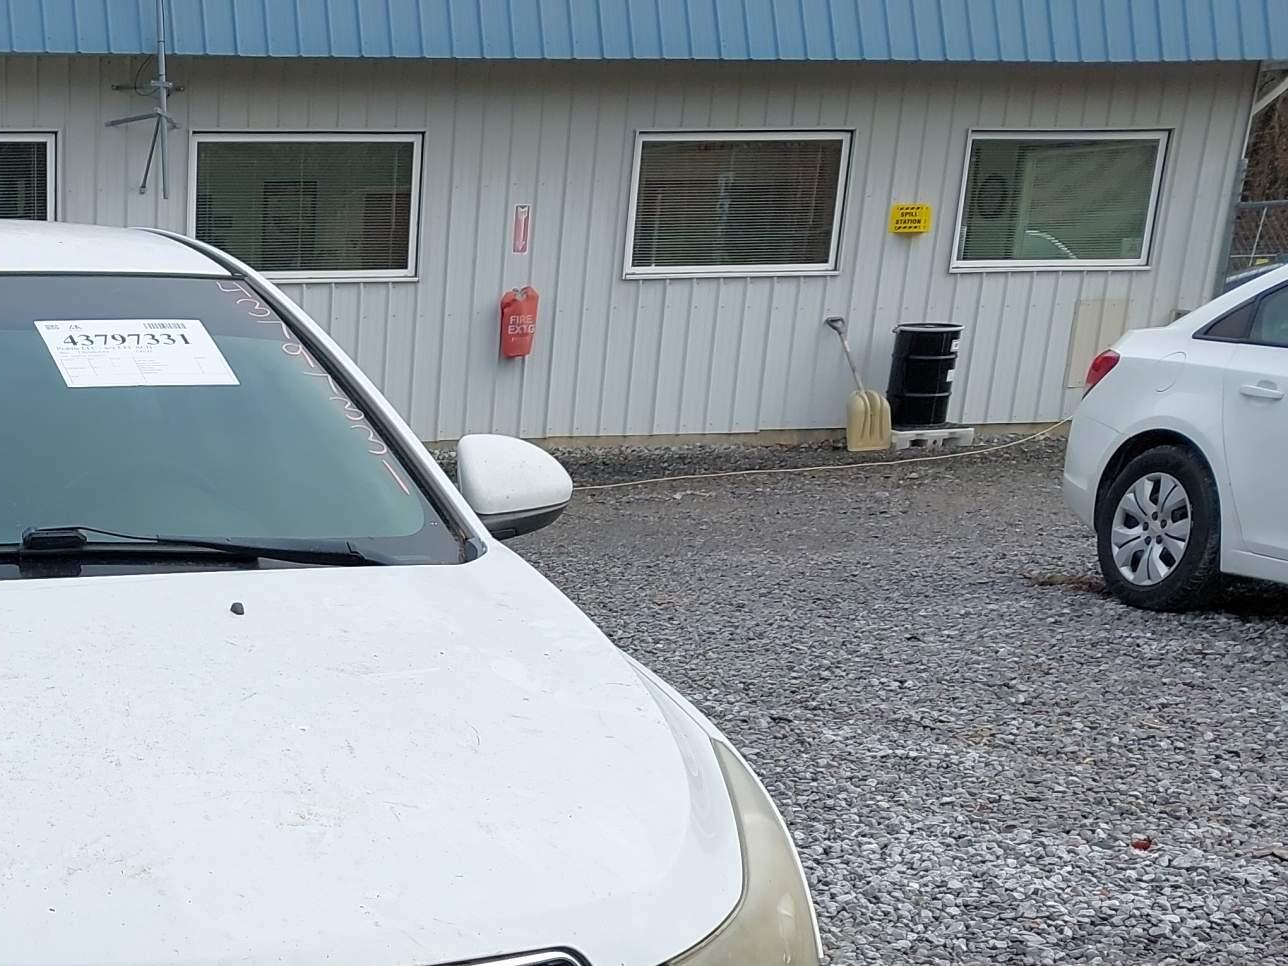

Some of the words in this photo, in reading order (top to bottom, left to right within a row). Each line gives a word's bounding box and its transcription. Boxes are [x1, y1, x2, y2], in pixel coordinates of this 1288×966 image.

[510, 315, 533, 324] FIRE
[63, 333, 192, 345] 43797331
[215, 280, 410, 496] 43797331
